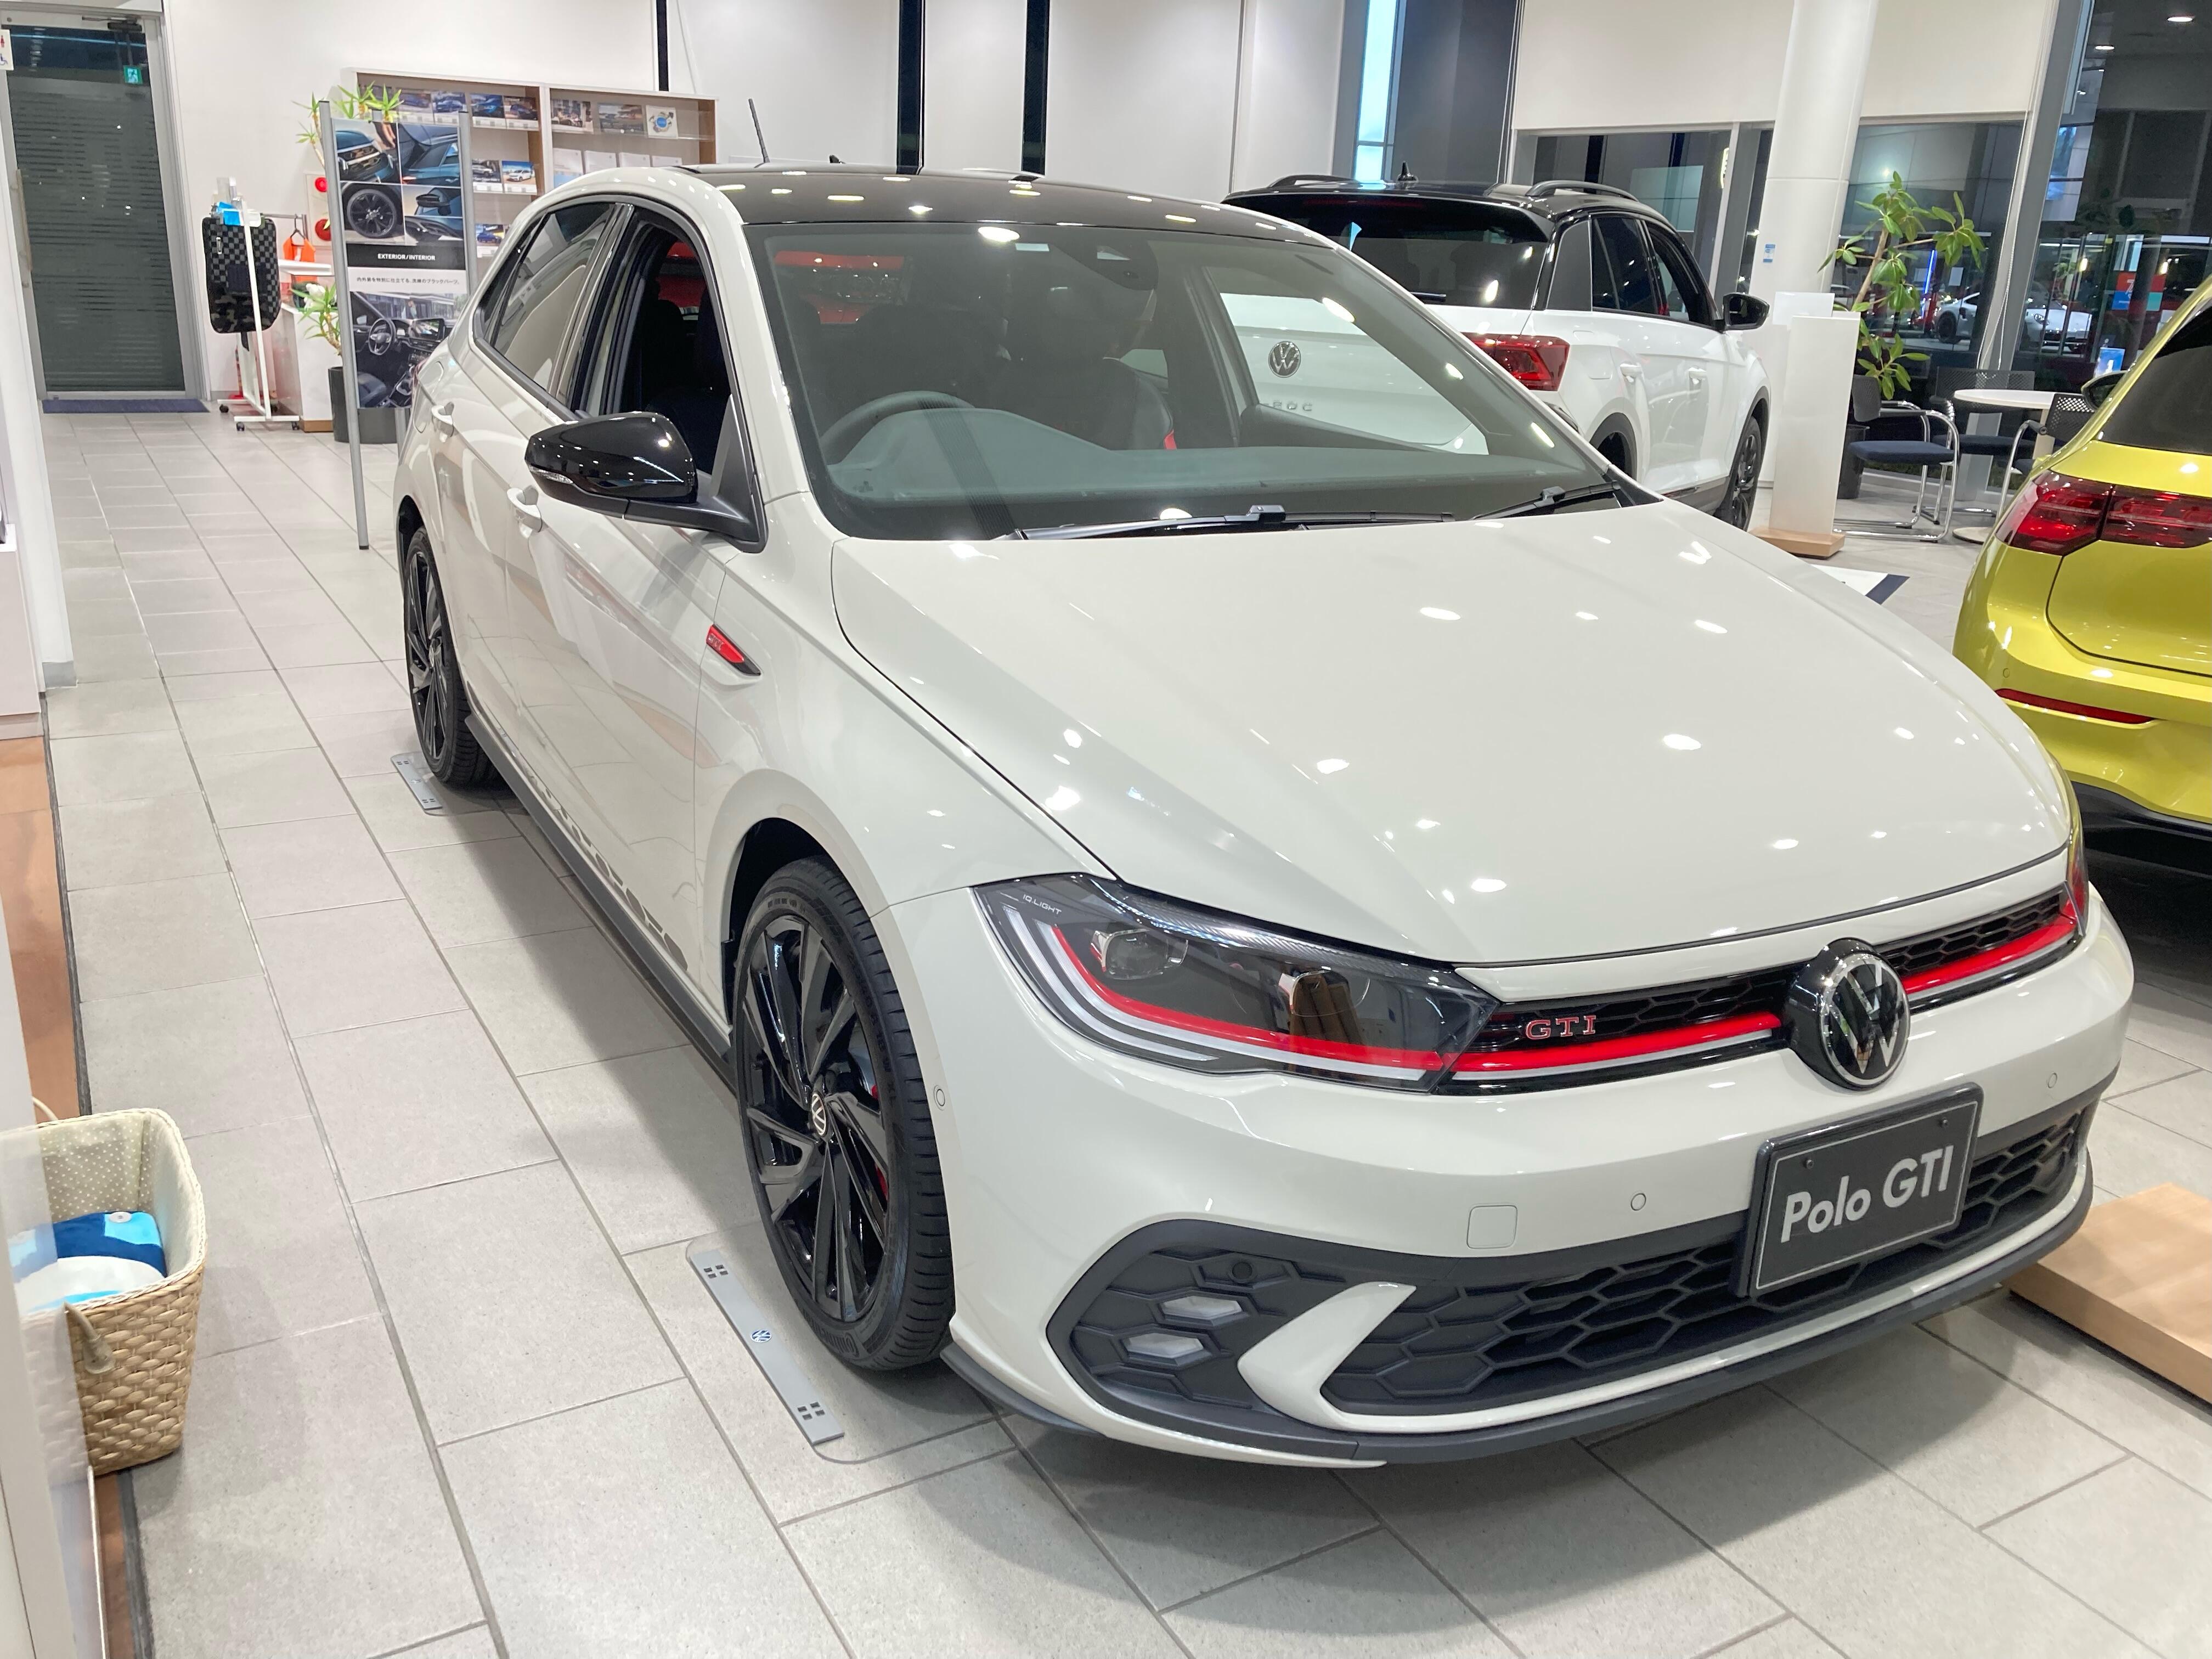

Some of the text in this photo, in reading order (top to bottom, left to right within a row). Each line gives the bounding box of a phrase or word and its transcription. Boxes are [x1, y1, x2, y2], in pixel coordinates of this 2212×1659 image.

[1023, 894, 1062, 915] IQ.LIGHT
[1525, 1015, 1596, 1040] GTI
[1781, 1145, 1954, 1243] Polo GTI
